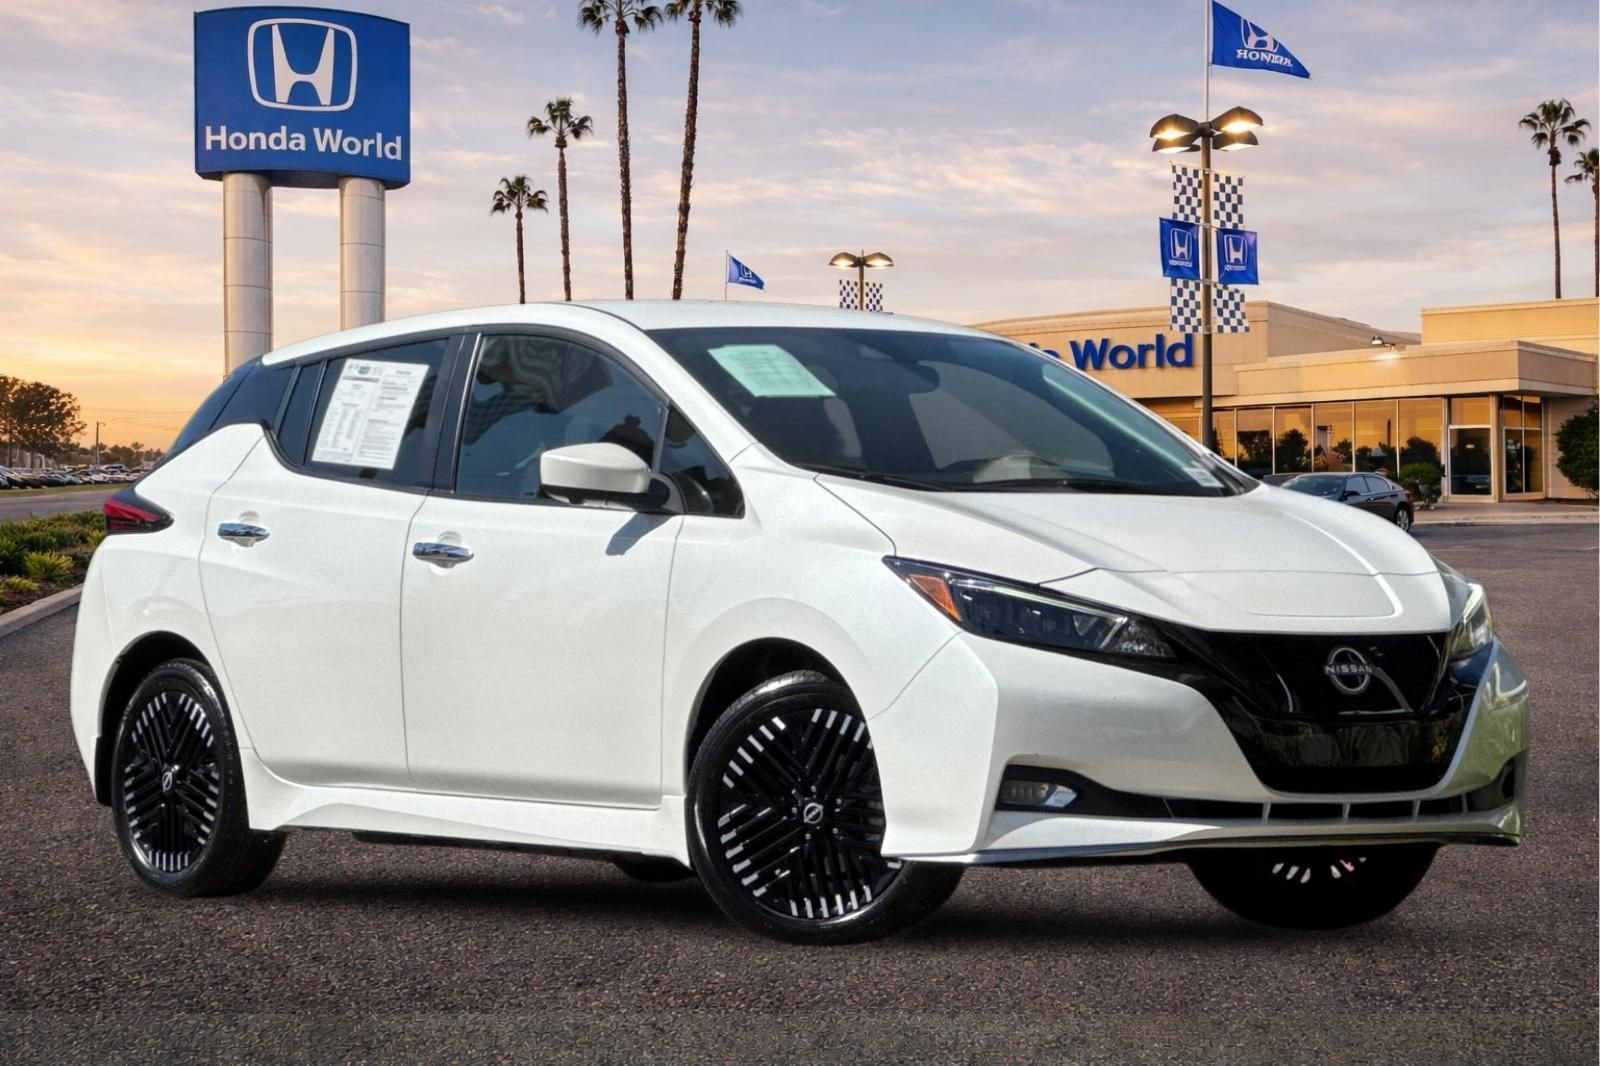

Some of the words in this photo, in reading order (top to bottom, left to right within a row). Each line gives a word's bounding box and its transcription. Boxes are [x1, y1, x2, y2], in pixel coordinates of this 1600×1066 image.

[205, 125, 306, 151] Honda
[313, 127, 402, 160] World
[1069, 333, 1193, 370] World
[1325, 664, 1372, 673] NISSAN
